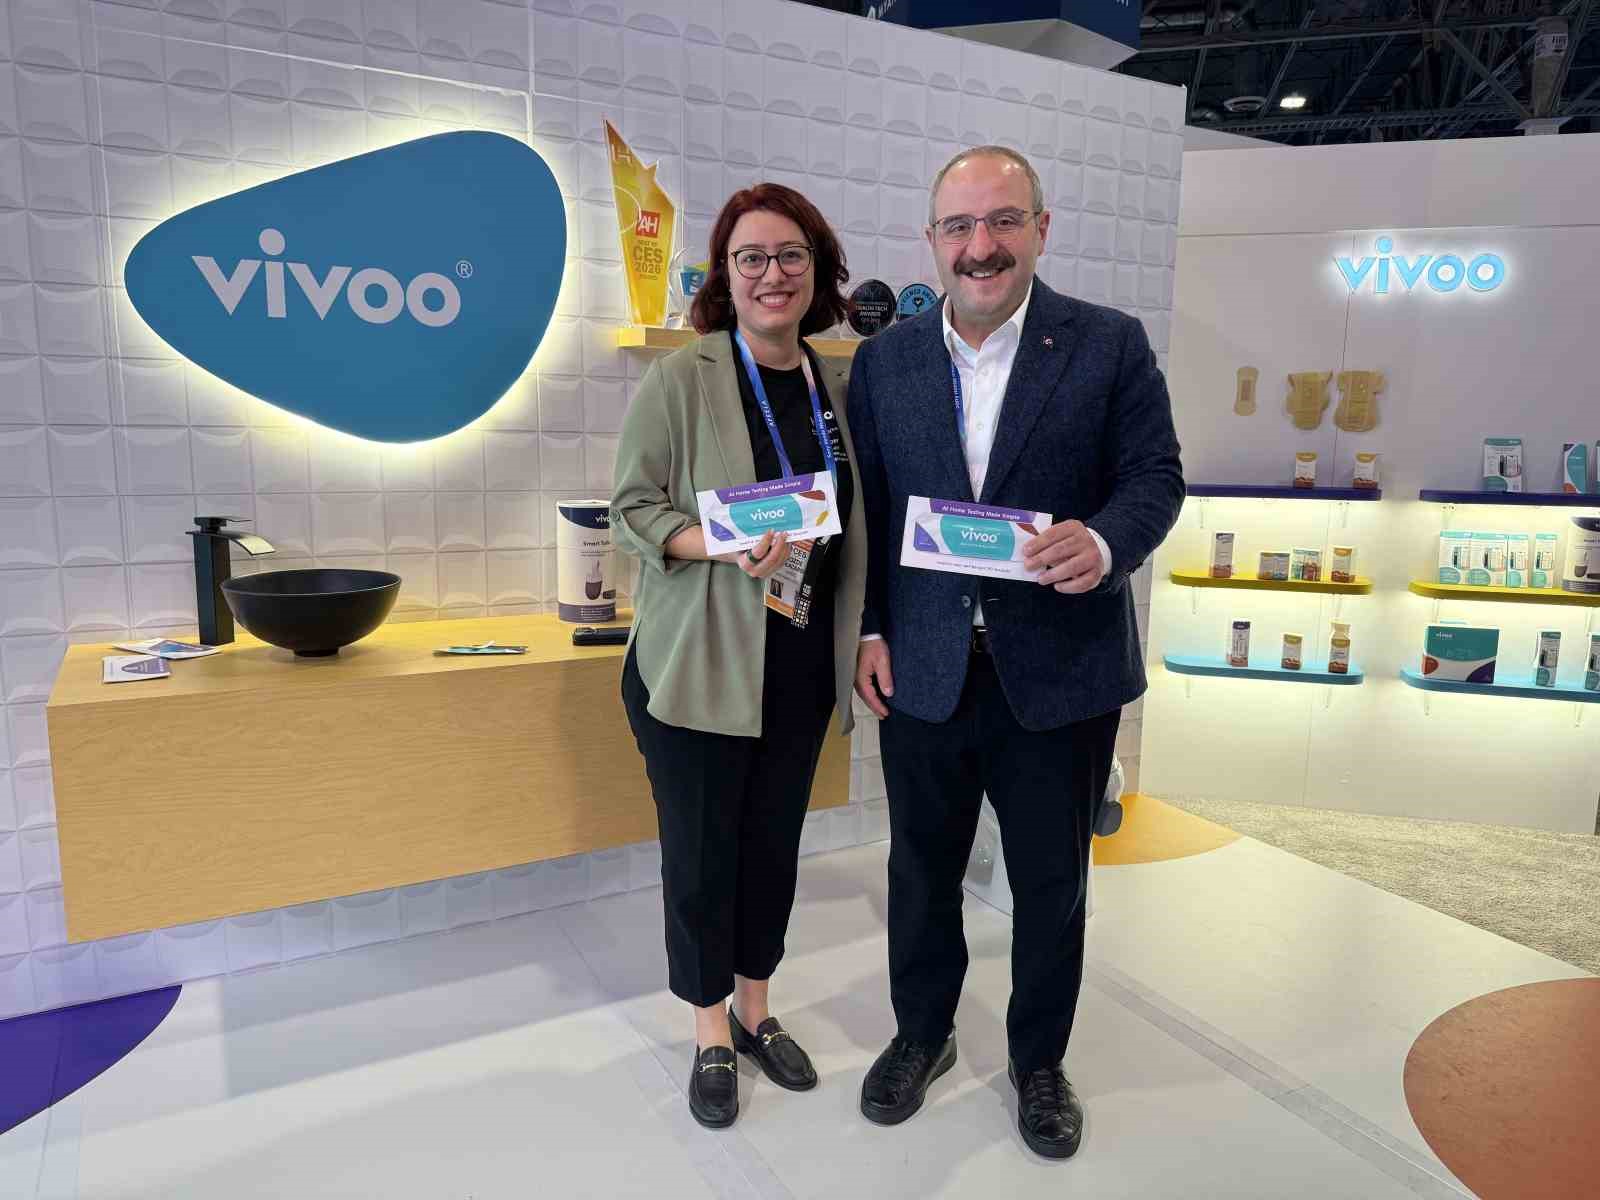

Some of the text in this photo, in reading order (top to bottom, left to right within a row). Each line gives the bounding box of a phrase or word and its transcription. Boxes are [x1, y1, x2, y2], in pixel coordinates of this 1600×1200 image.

[637, 215, 658, 234] AH
[633, 246, 663, 263] CES
[1332, 235, 1505, 293] vivoo
[750, 508, 784, 521] vivoo
[960, 527, 998, 543] vivoo
